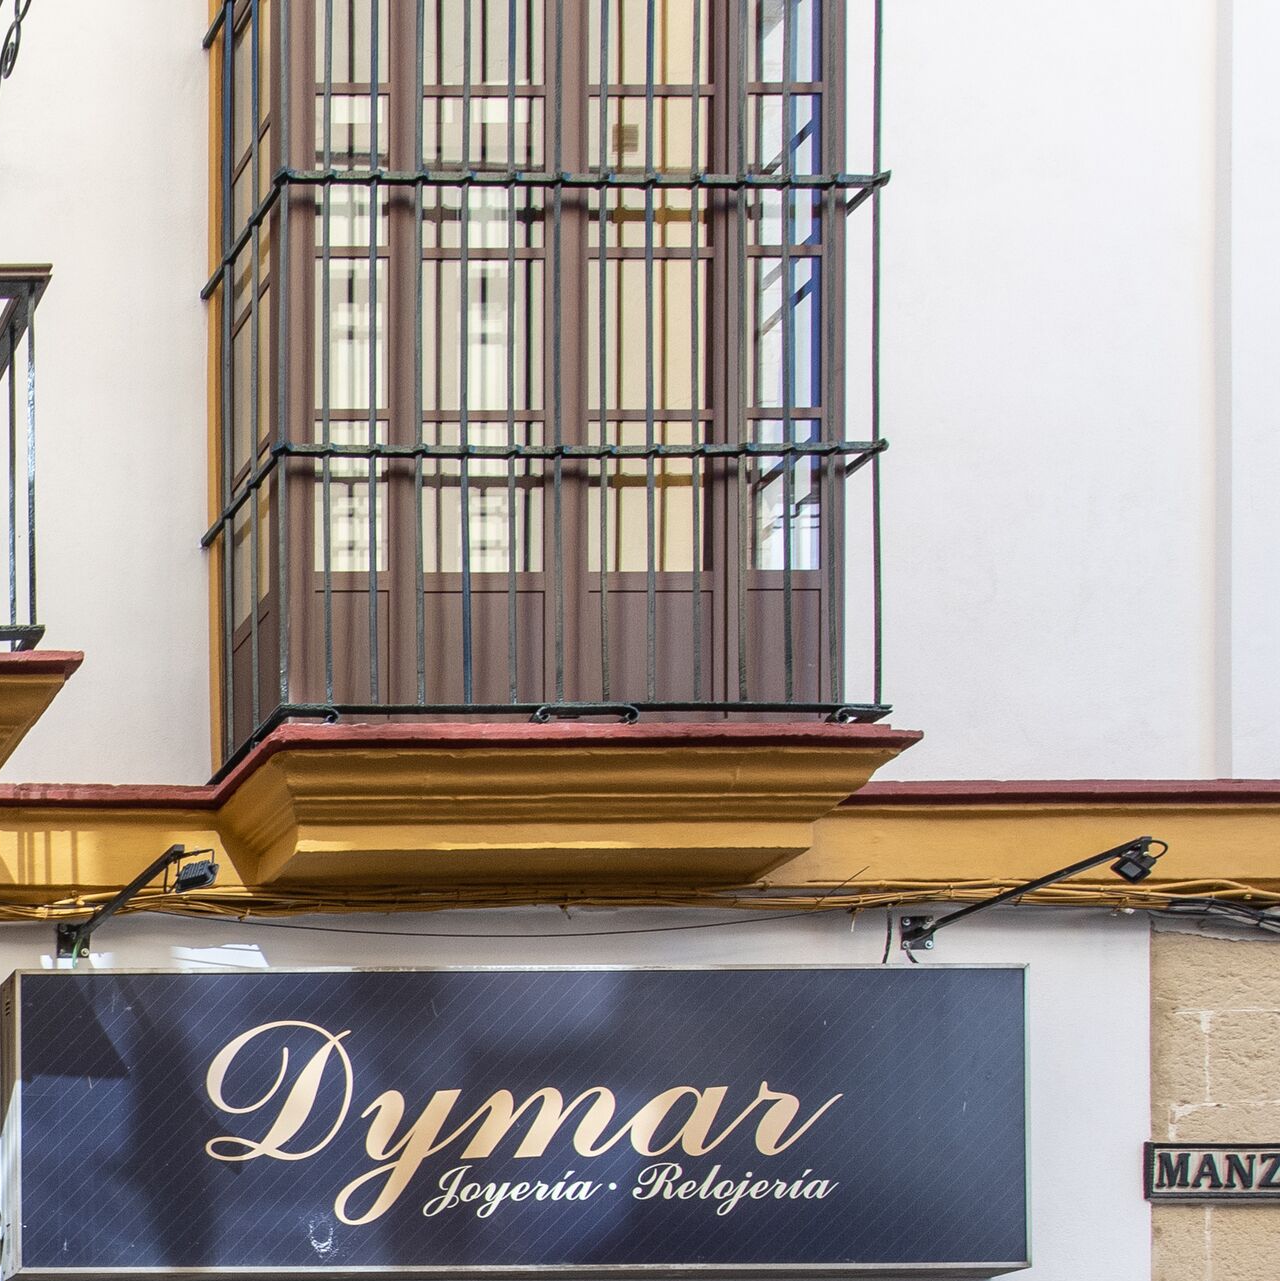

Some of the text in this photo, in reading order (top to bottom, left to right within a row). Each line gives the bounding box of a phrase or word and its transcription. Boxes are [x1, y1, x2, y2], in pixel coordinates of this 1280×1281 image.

[206, 1021, 842, 1226] Dymar
[422, 1162, 839, 1218] Joyería Relojería
[1155, 1152, 1280, 1188] MANZ
